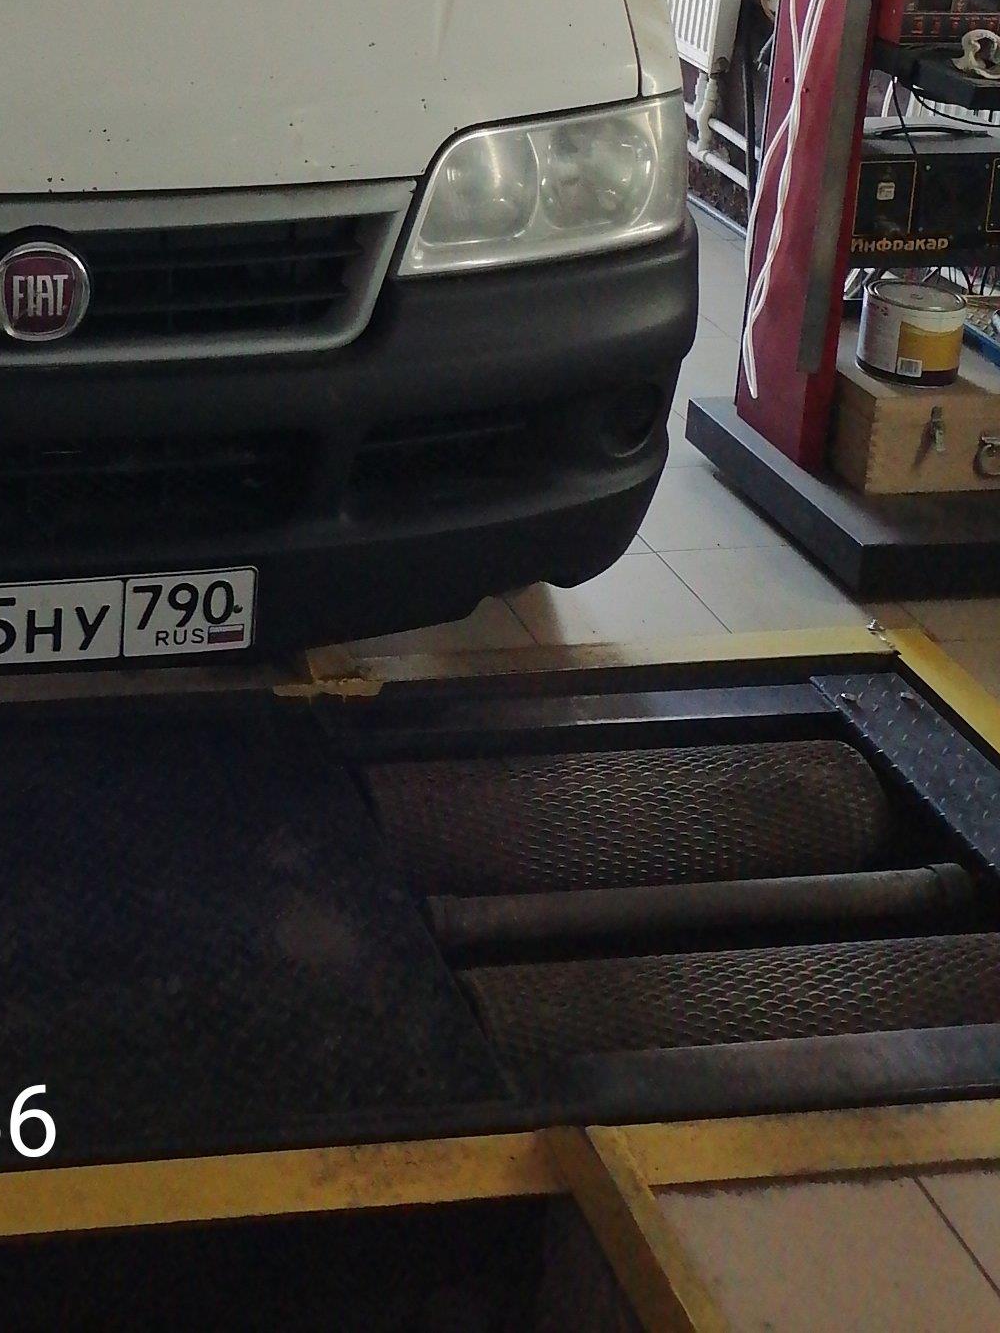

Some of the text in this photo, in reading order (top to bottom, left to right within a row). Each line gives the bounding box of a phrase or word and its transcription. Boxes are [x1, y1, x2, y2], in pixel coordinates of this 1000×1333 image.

[12, 274, 69, 320] FIAT
[132, 580, 235, 630] 790
[155, 628, 205, 647] RUS
